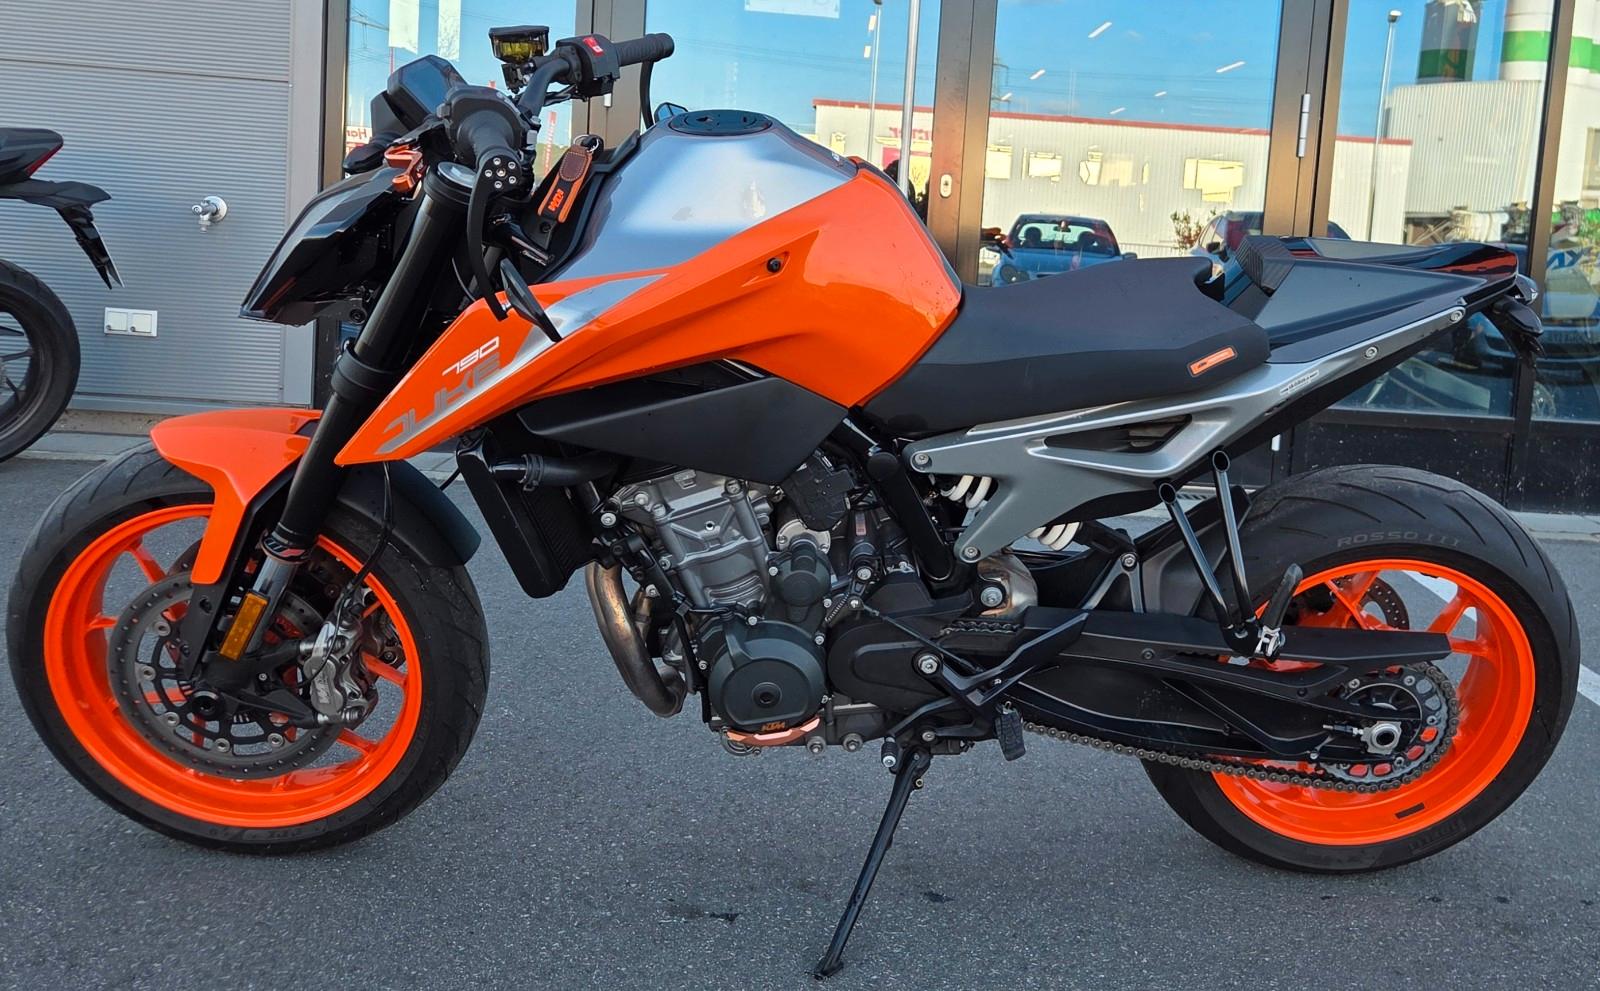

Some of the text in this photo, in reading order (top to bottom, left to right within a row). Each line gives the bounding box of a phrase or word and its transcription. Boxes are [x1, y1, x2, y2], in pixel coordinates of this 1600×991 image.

[441, 335, 500, 376] 790
[374, 351, 500, 455] DUKE
[1336, 531, 1418, 548] ROSSO
[761, 721, 786, 732] KTM
